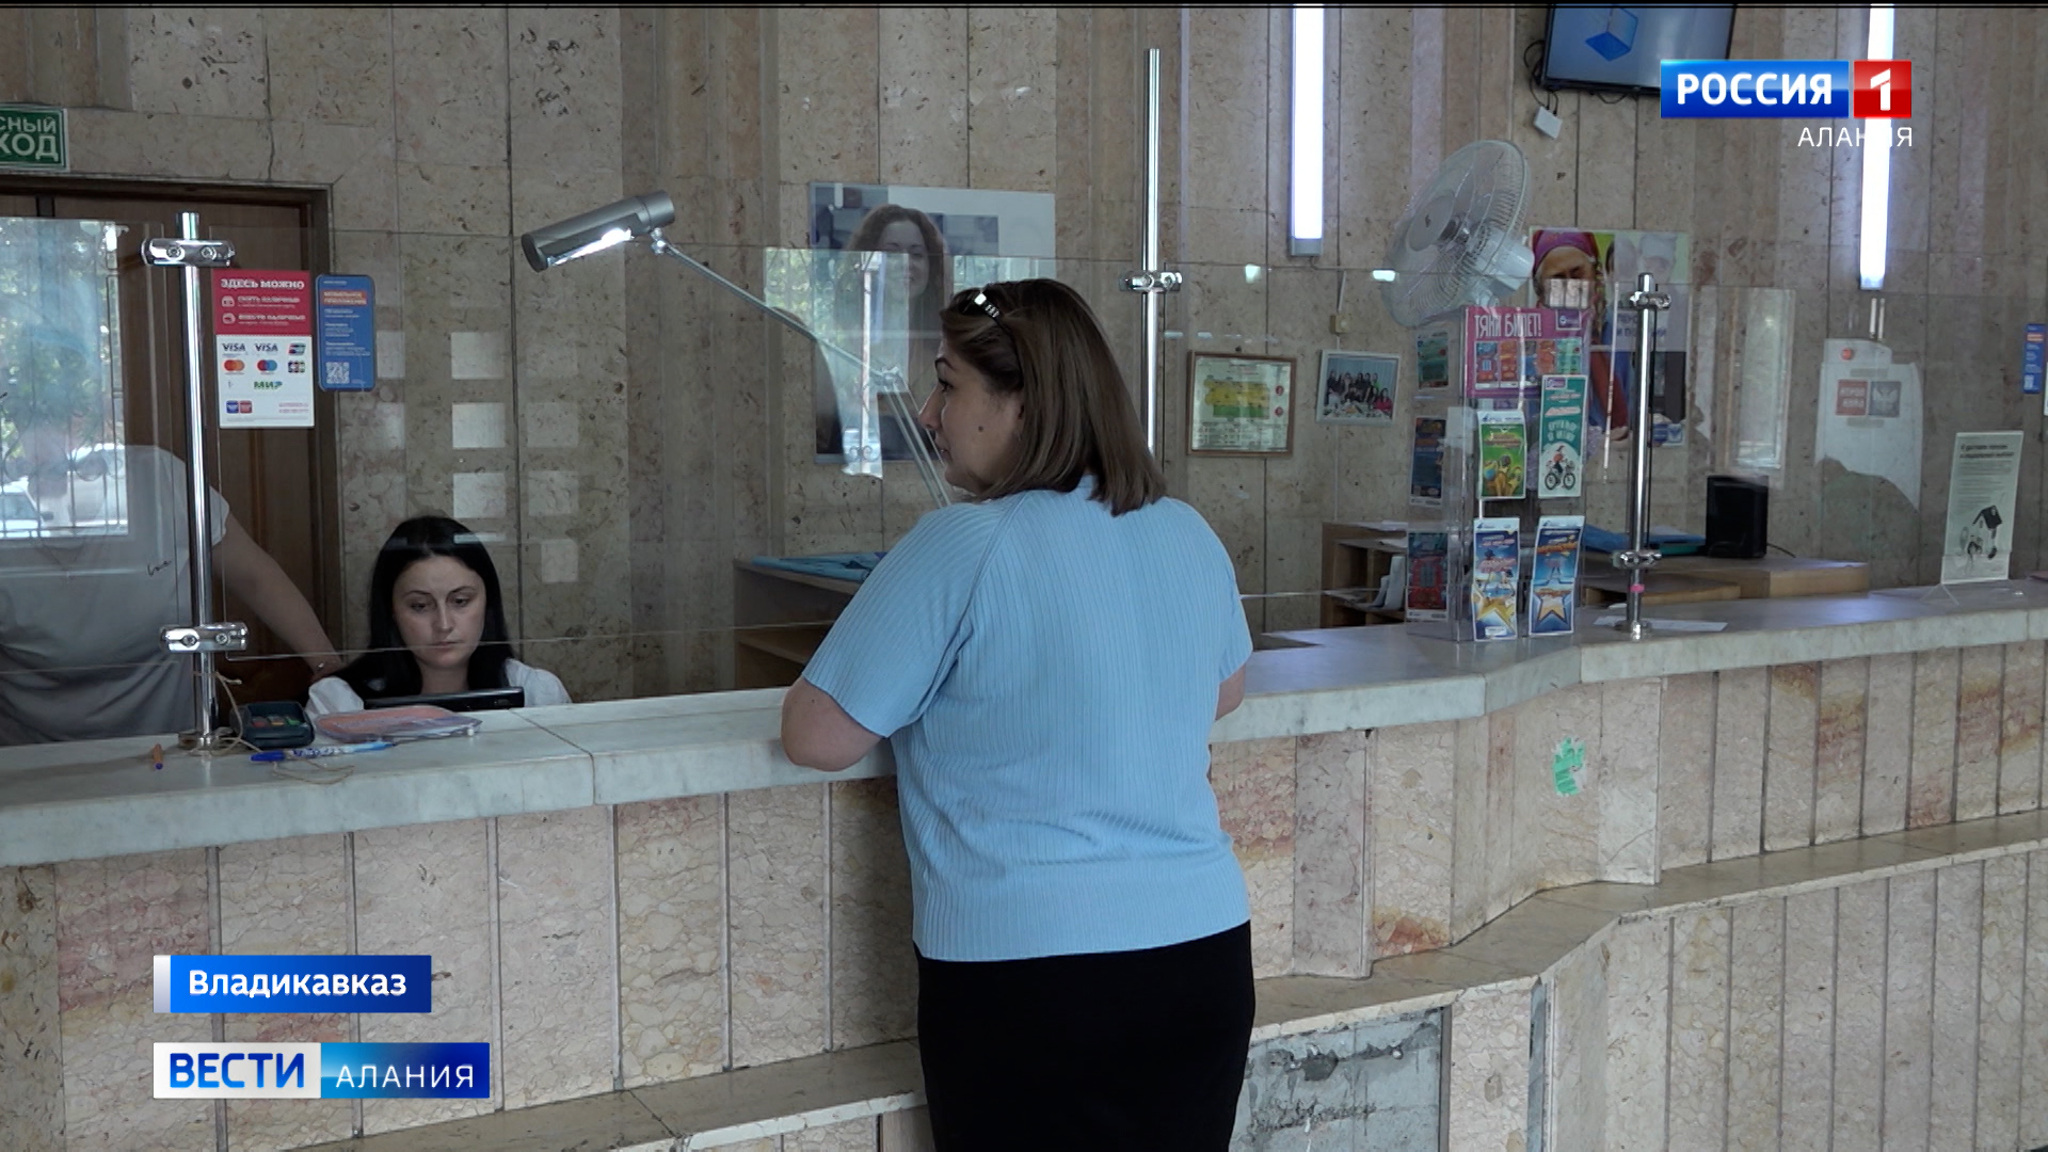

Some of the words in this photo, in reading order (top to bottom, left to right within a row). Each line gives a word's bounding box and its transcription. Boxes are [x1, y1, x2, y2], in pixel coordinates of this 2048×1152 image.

[221, 278, 258, 289] ЗДЕСЬ
[260, 280, 305, 290] МОЖНО
[222, 343, 246, 352] VISA
[255, 343, 278, 352] VISA
